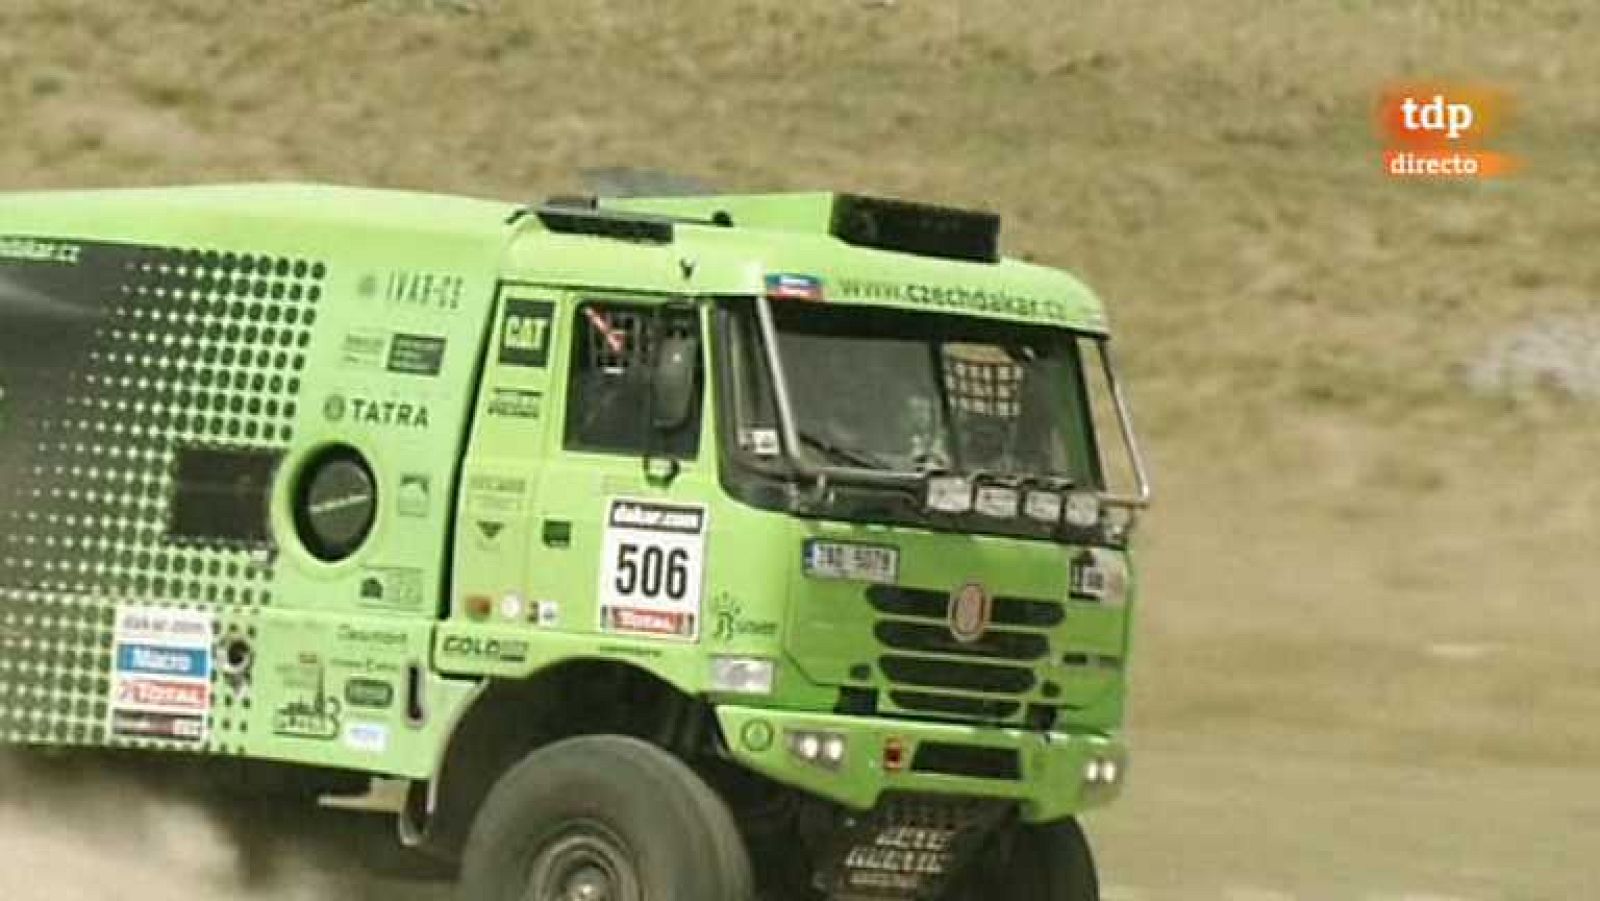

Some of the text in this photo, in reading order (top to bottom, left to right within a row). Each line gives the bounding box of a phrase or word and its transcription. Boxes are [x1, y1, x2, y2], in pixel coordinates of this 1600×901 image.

[505, 315, 548, 350] CAT
[350, 398, 430, 429] TATRA
[613, 504, 699, 529] dakar.com
[615, 543, 689, 601] 506
[133, 683, 205, 706] TOTAL
